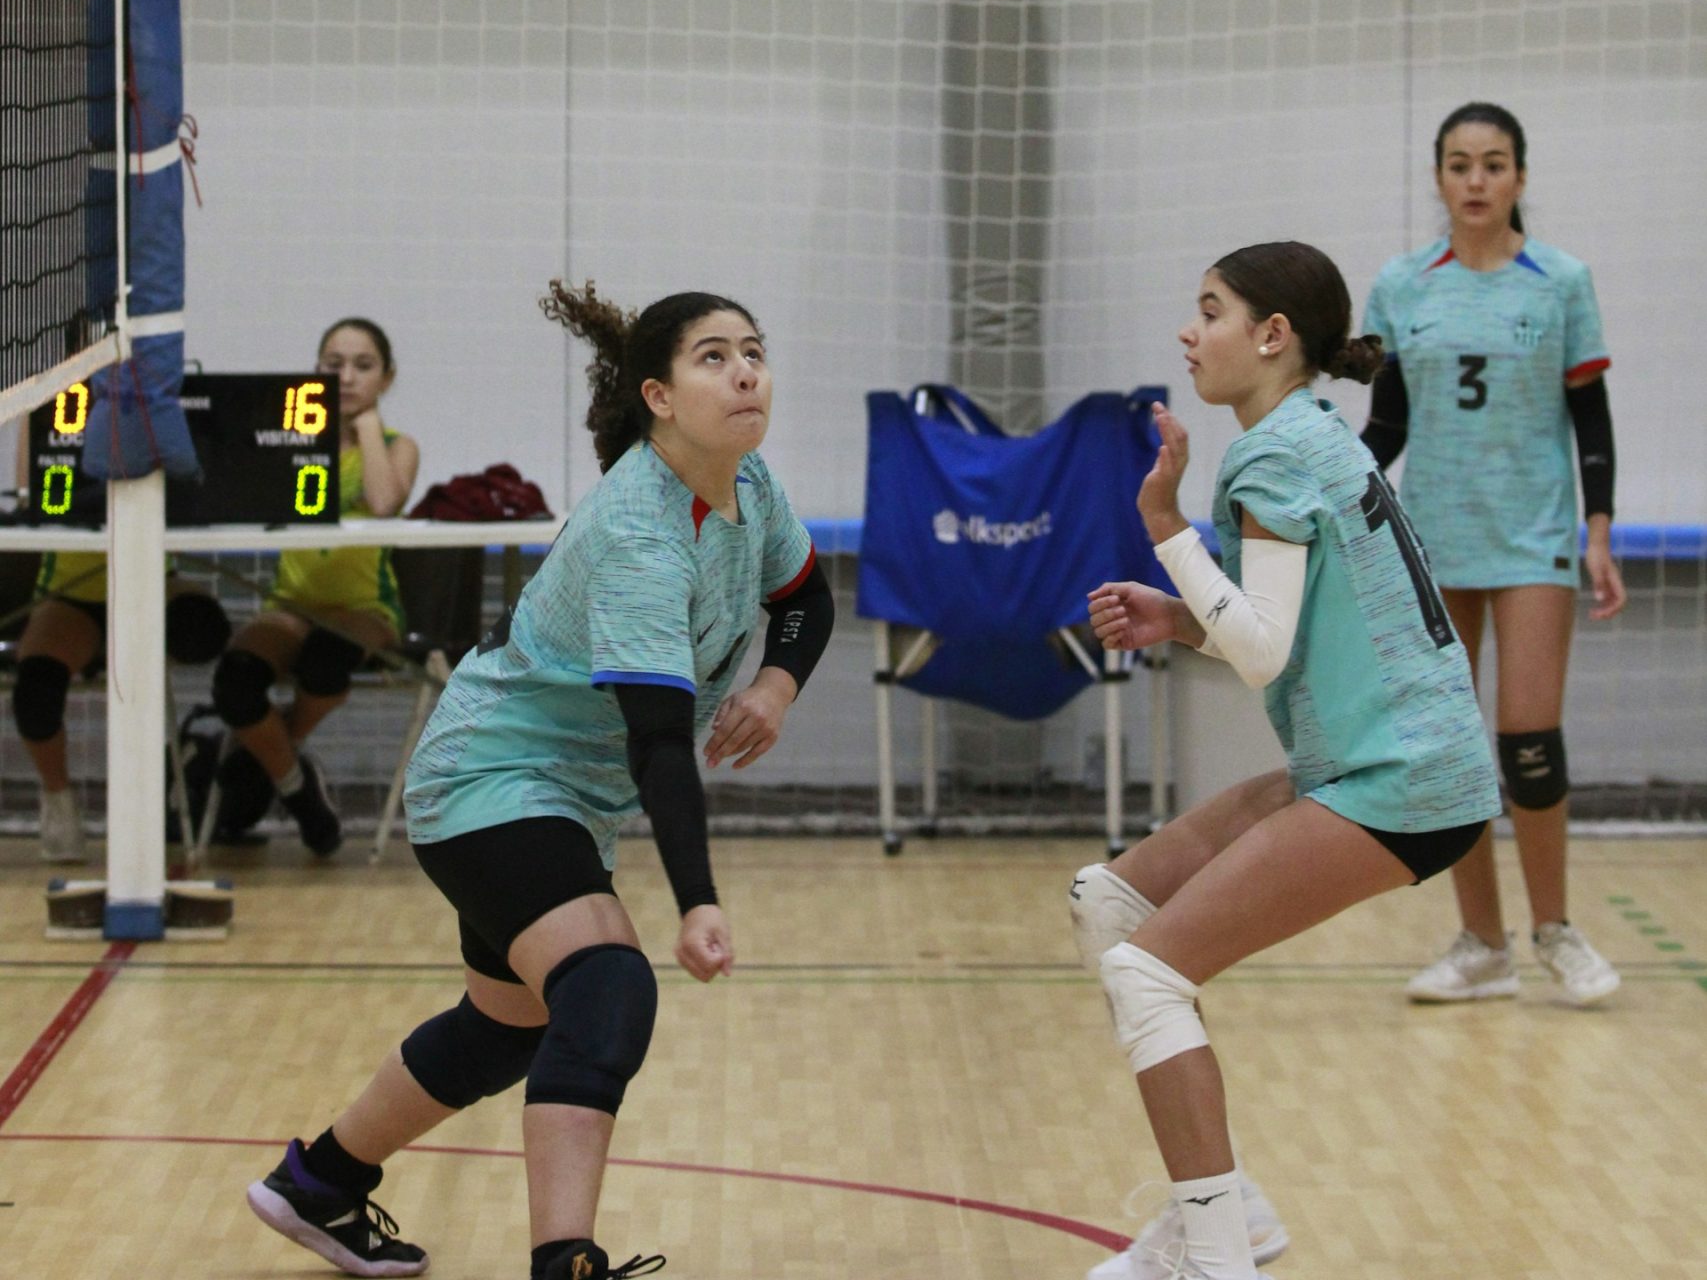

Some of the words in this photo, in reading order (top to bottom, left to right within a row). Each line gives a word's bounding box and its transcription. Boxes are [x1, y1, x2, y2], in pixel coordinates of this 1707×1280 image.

[1457, 354, 1488, 410] 3
[54, 382, 89, 434] 0
[283, 382, 327, 434] 16
[48, 430, 84, 447] LOC
[255, 430, 317, 447] VISITANT
[41, 464, 73, 514] 0
[295, 464, 328, 515] 0
[780, 610, 805, 643] KIPSTA
